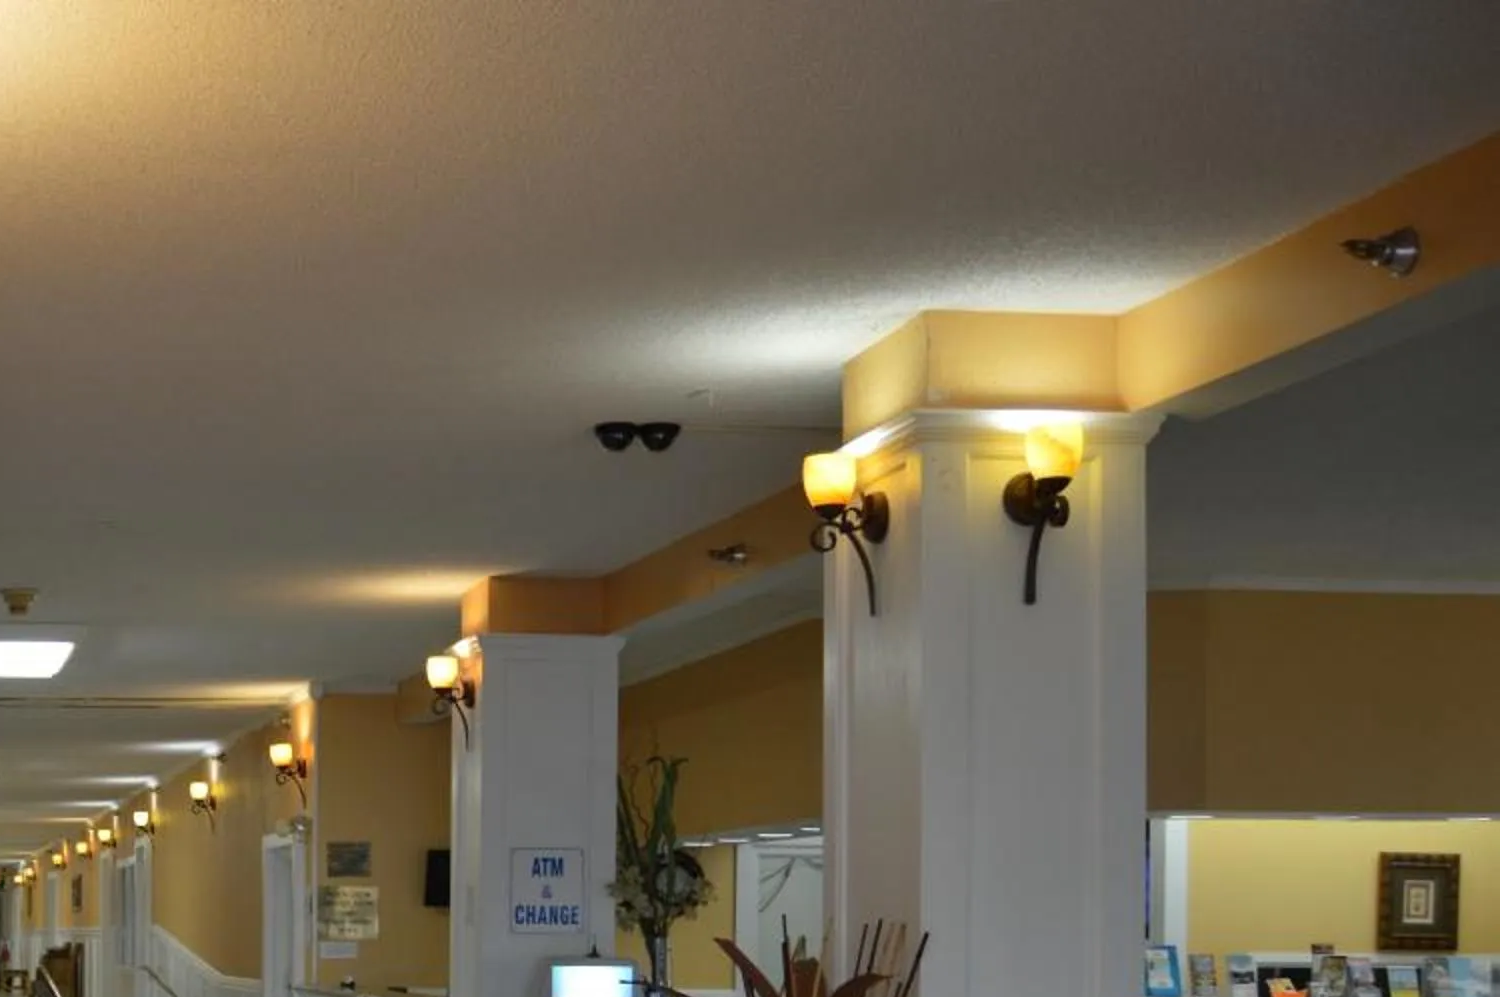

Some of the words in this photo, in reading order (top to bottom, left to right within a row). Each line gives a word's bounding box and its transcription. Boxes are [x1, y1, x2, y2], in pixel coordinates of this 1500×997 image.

[531, 856, 564, 878] ATM
[541, 884, 553, 899] &
[514, 904, 580, 926] CHANGE
